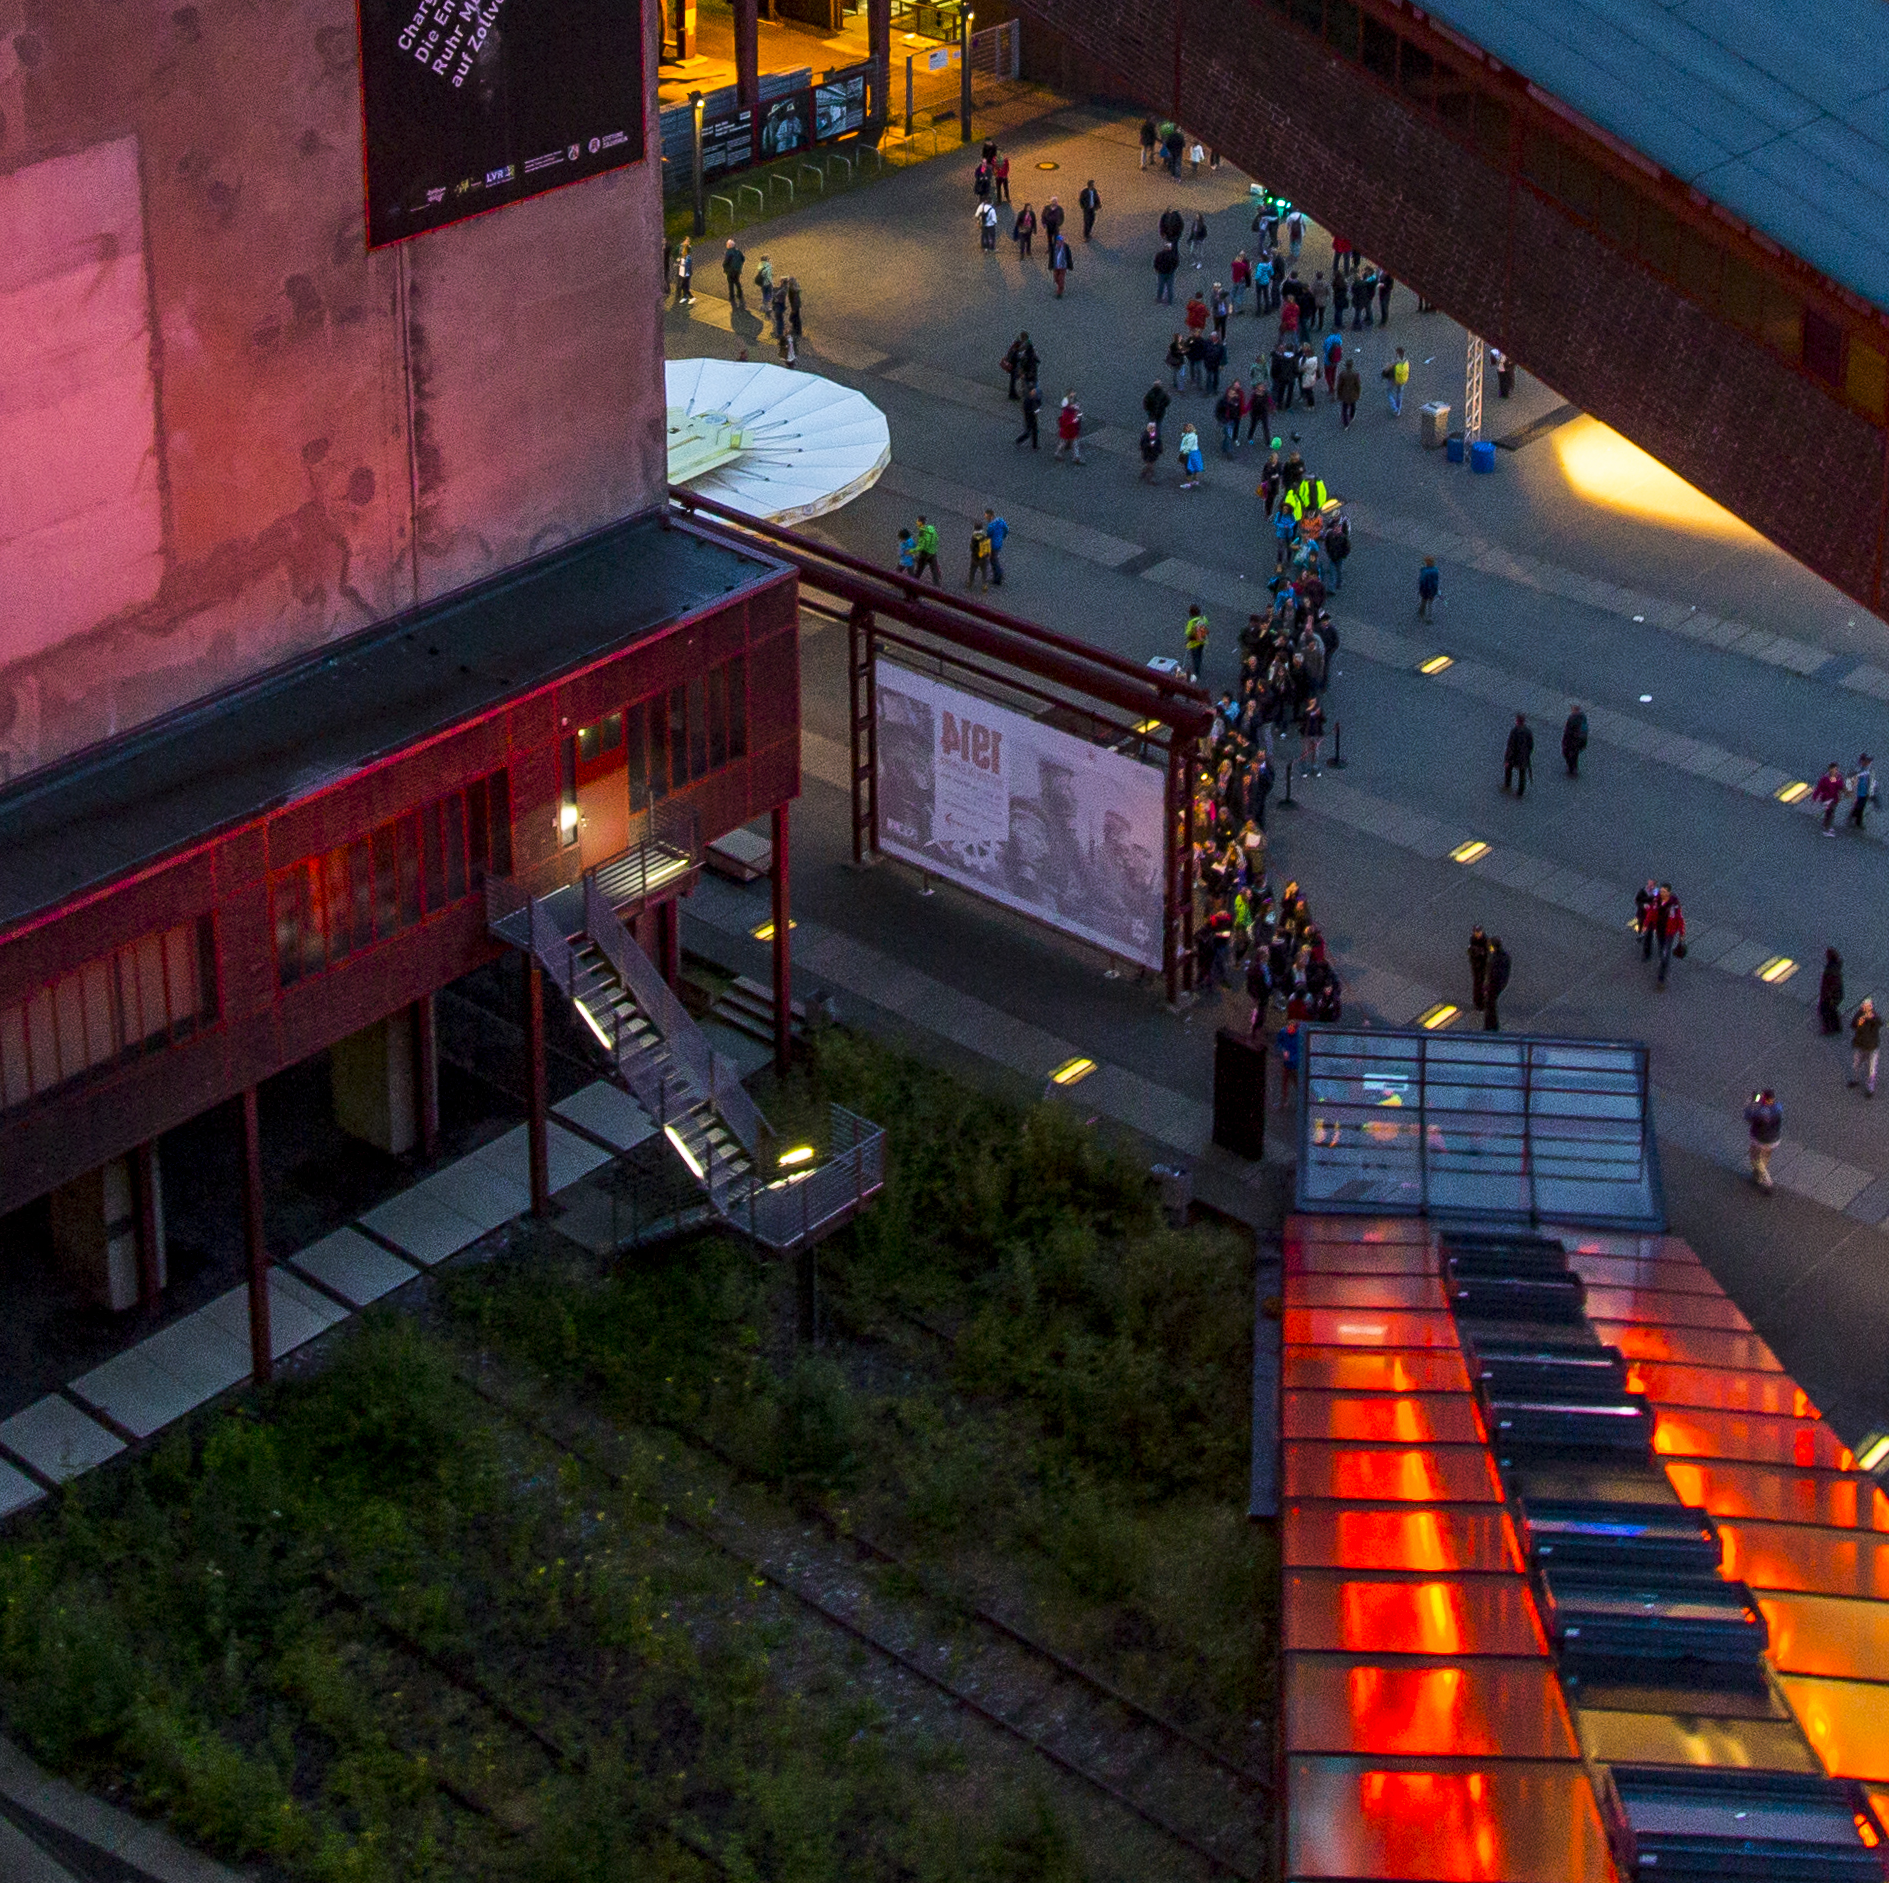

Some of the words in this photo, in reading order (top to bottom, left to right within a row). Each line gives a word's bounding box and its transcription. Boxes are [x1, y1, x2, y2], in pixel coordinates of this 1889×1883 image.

[414, 26, 440, 63] Die
[431, 22, 464, 75] Ruhr
[449, 51, 473, 87] auf
